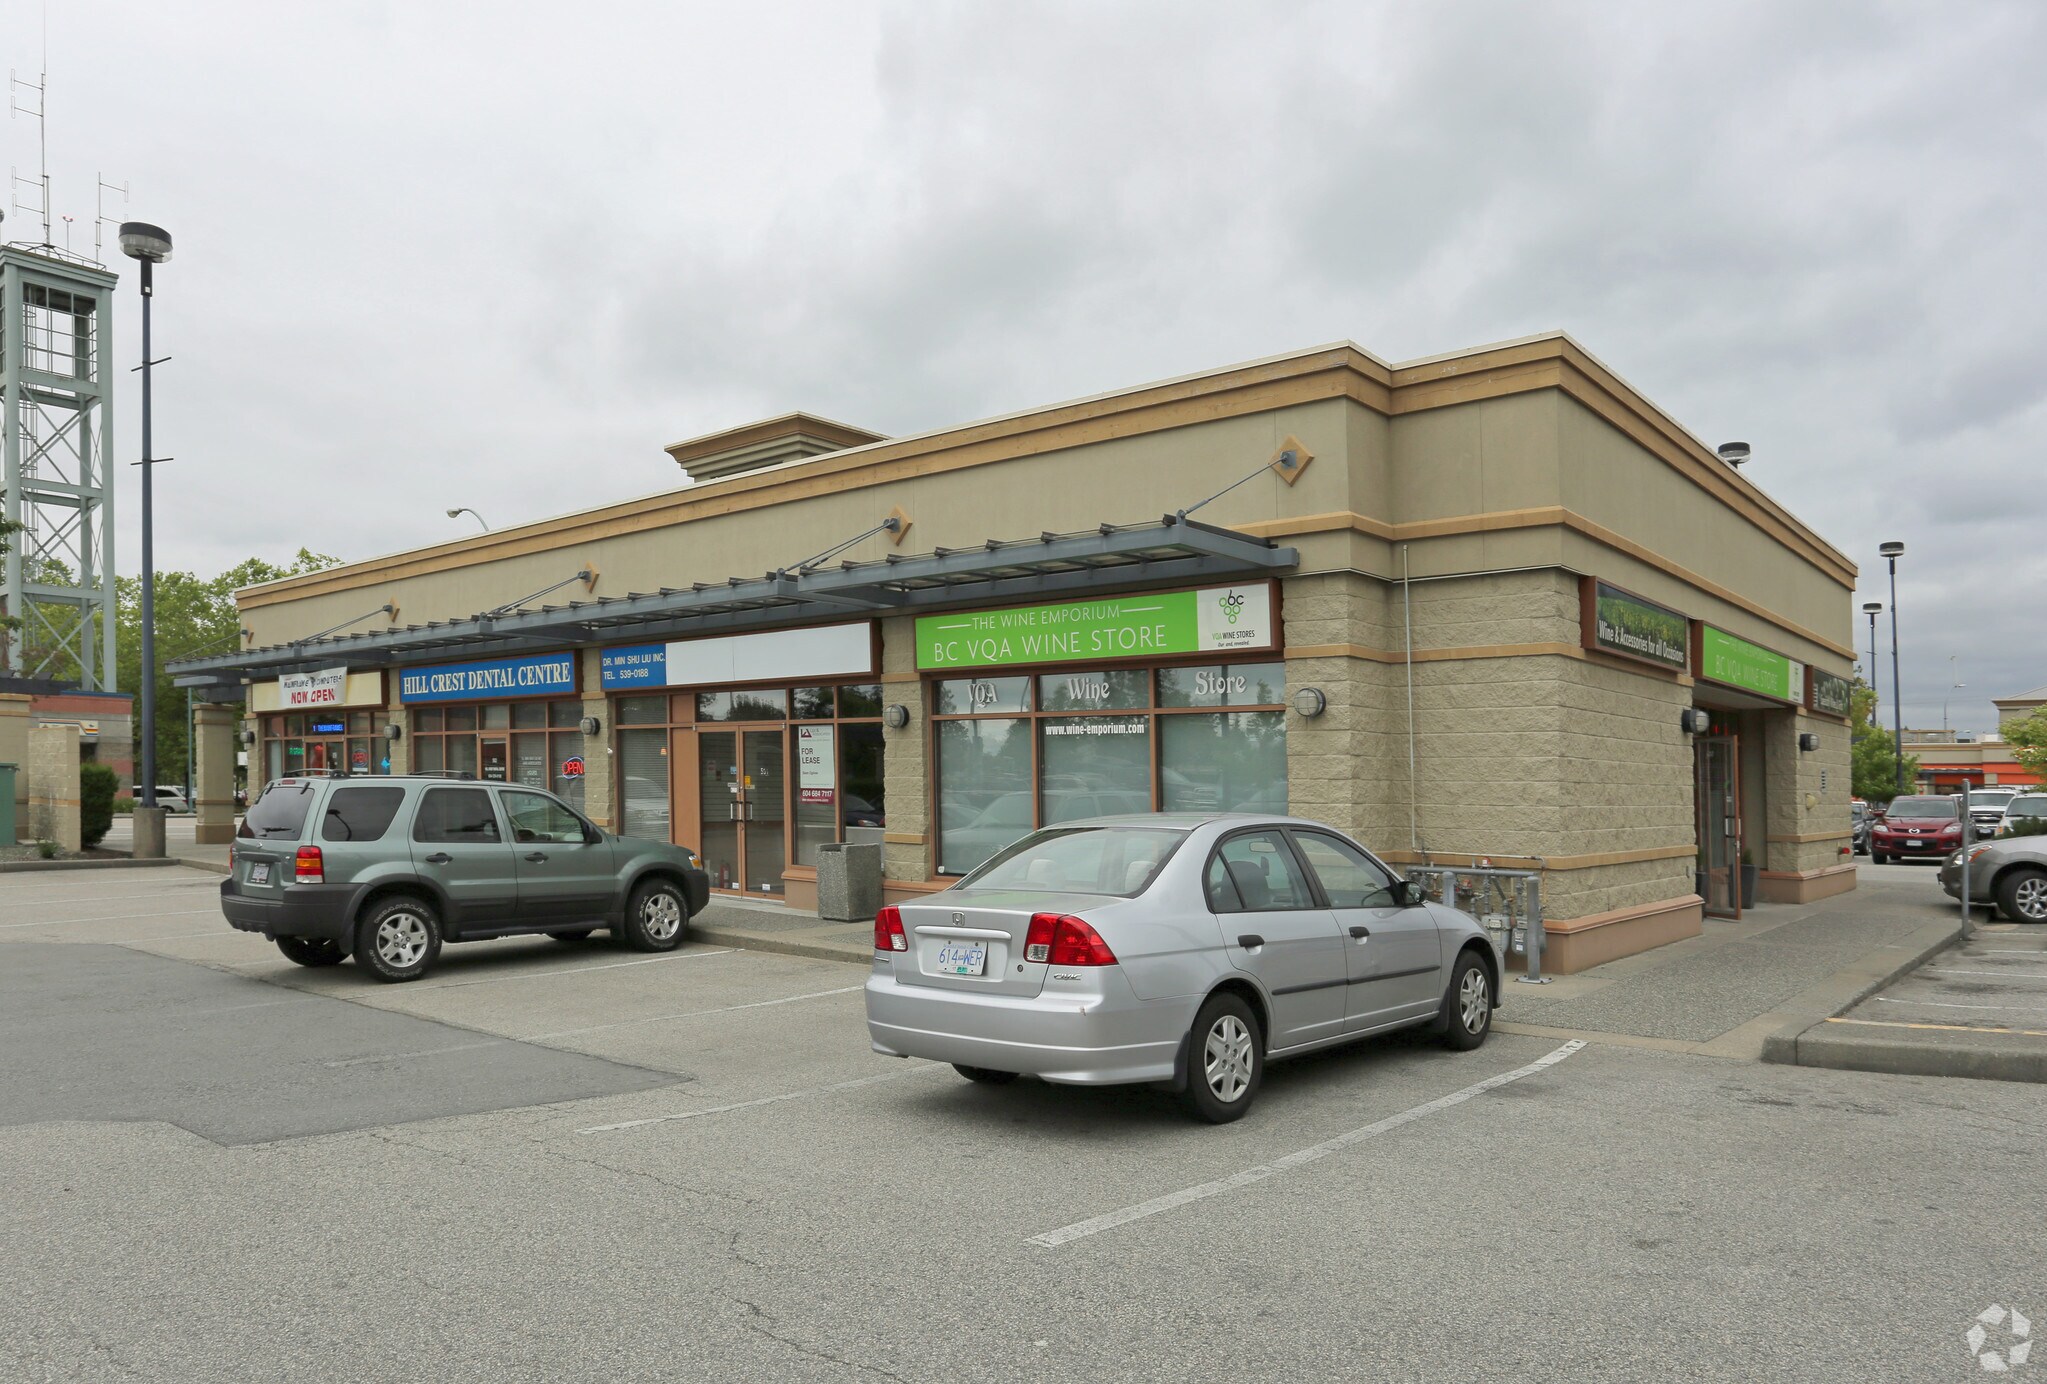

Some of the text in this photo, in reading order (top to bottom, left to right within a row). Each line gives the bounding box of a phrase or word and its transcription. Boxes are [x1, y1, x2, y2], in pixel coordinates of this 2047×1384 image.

[971, 604, 1120, 630] THE WINE EMPORIUM
[1222, 631, 1236, 640] WINE
[1236, 629, 1256, 639] STORES
[1599, 619, 1614, 642] Wine
[1620, 627, 1648, 652] Accessories
[1663, 641, 1684, 663] Occasions
[934, 625, 1167, 662] BC VQA WINE STORE
[603, 652, 666, 666] DR. MIN SHU LIU INC.
[403, 662, 571, 695] HILL CREST DENTAL CENTRE
[619, 668, 649, 679] 539-0188
[290, 688, 335, 704] NOW OPEN
[967, 670, 1247, 708] VQA Wine Store
[1045, 722, 1145, 736] www.wine-emporium.com
[801, 747, 814, 755] FOR
[801, 756, 821, 764] LEASE
[561, 761, 584, 775] OPEN
[802, 789, 811, 797] 604
[811, 789, 821, 797] 684
